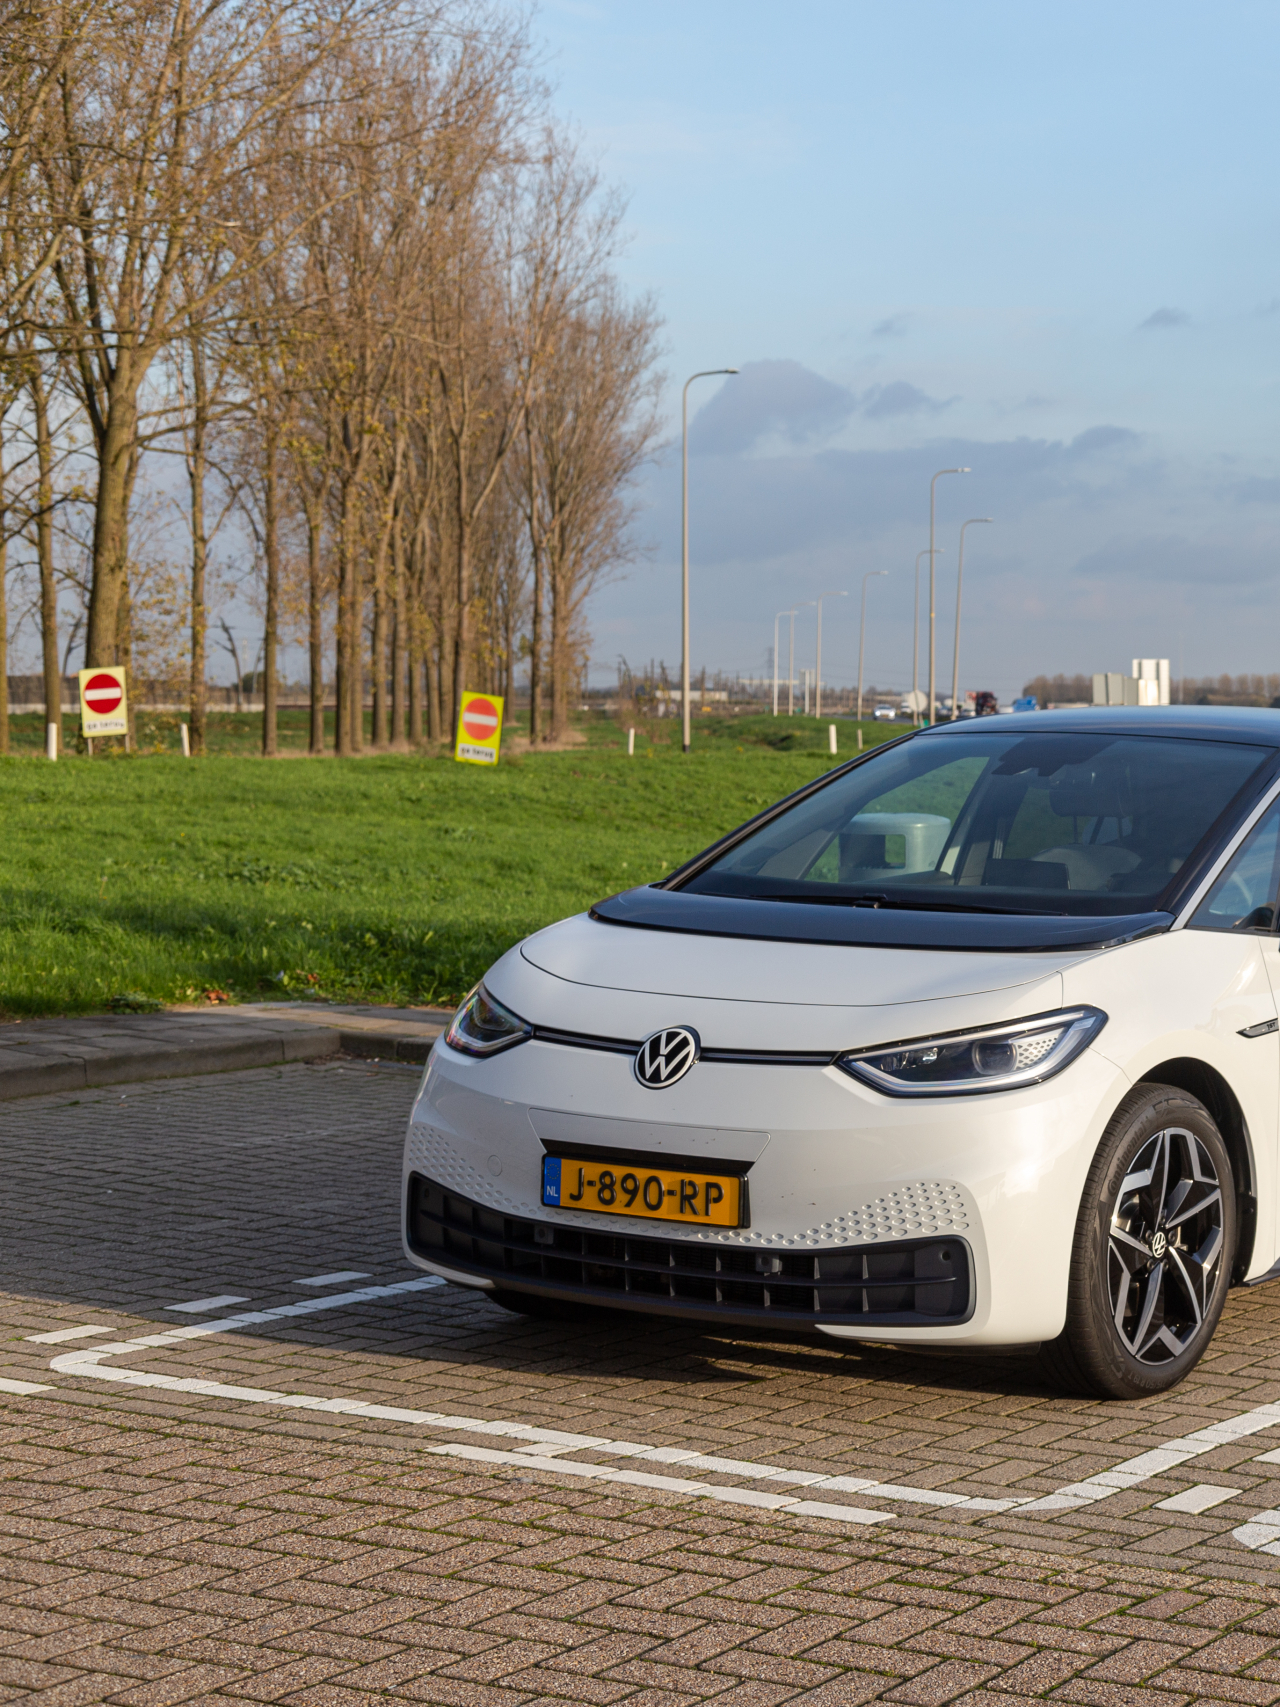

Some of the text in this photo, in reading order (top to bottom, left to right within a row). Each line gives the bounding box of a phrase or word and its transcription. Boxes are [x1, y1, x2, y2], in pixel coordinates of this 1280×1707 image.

[1108, 1122, 1147, 1197] Continental
[546, 1185, 559, 1197] NL
[569, 1167, 724, 1216] J-890-RP
